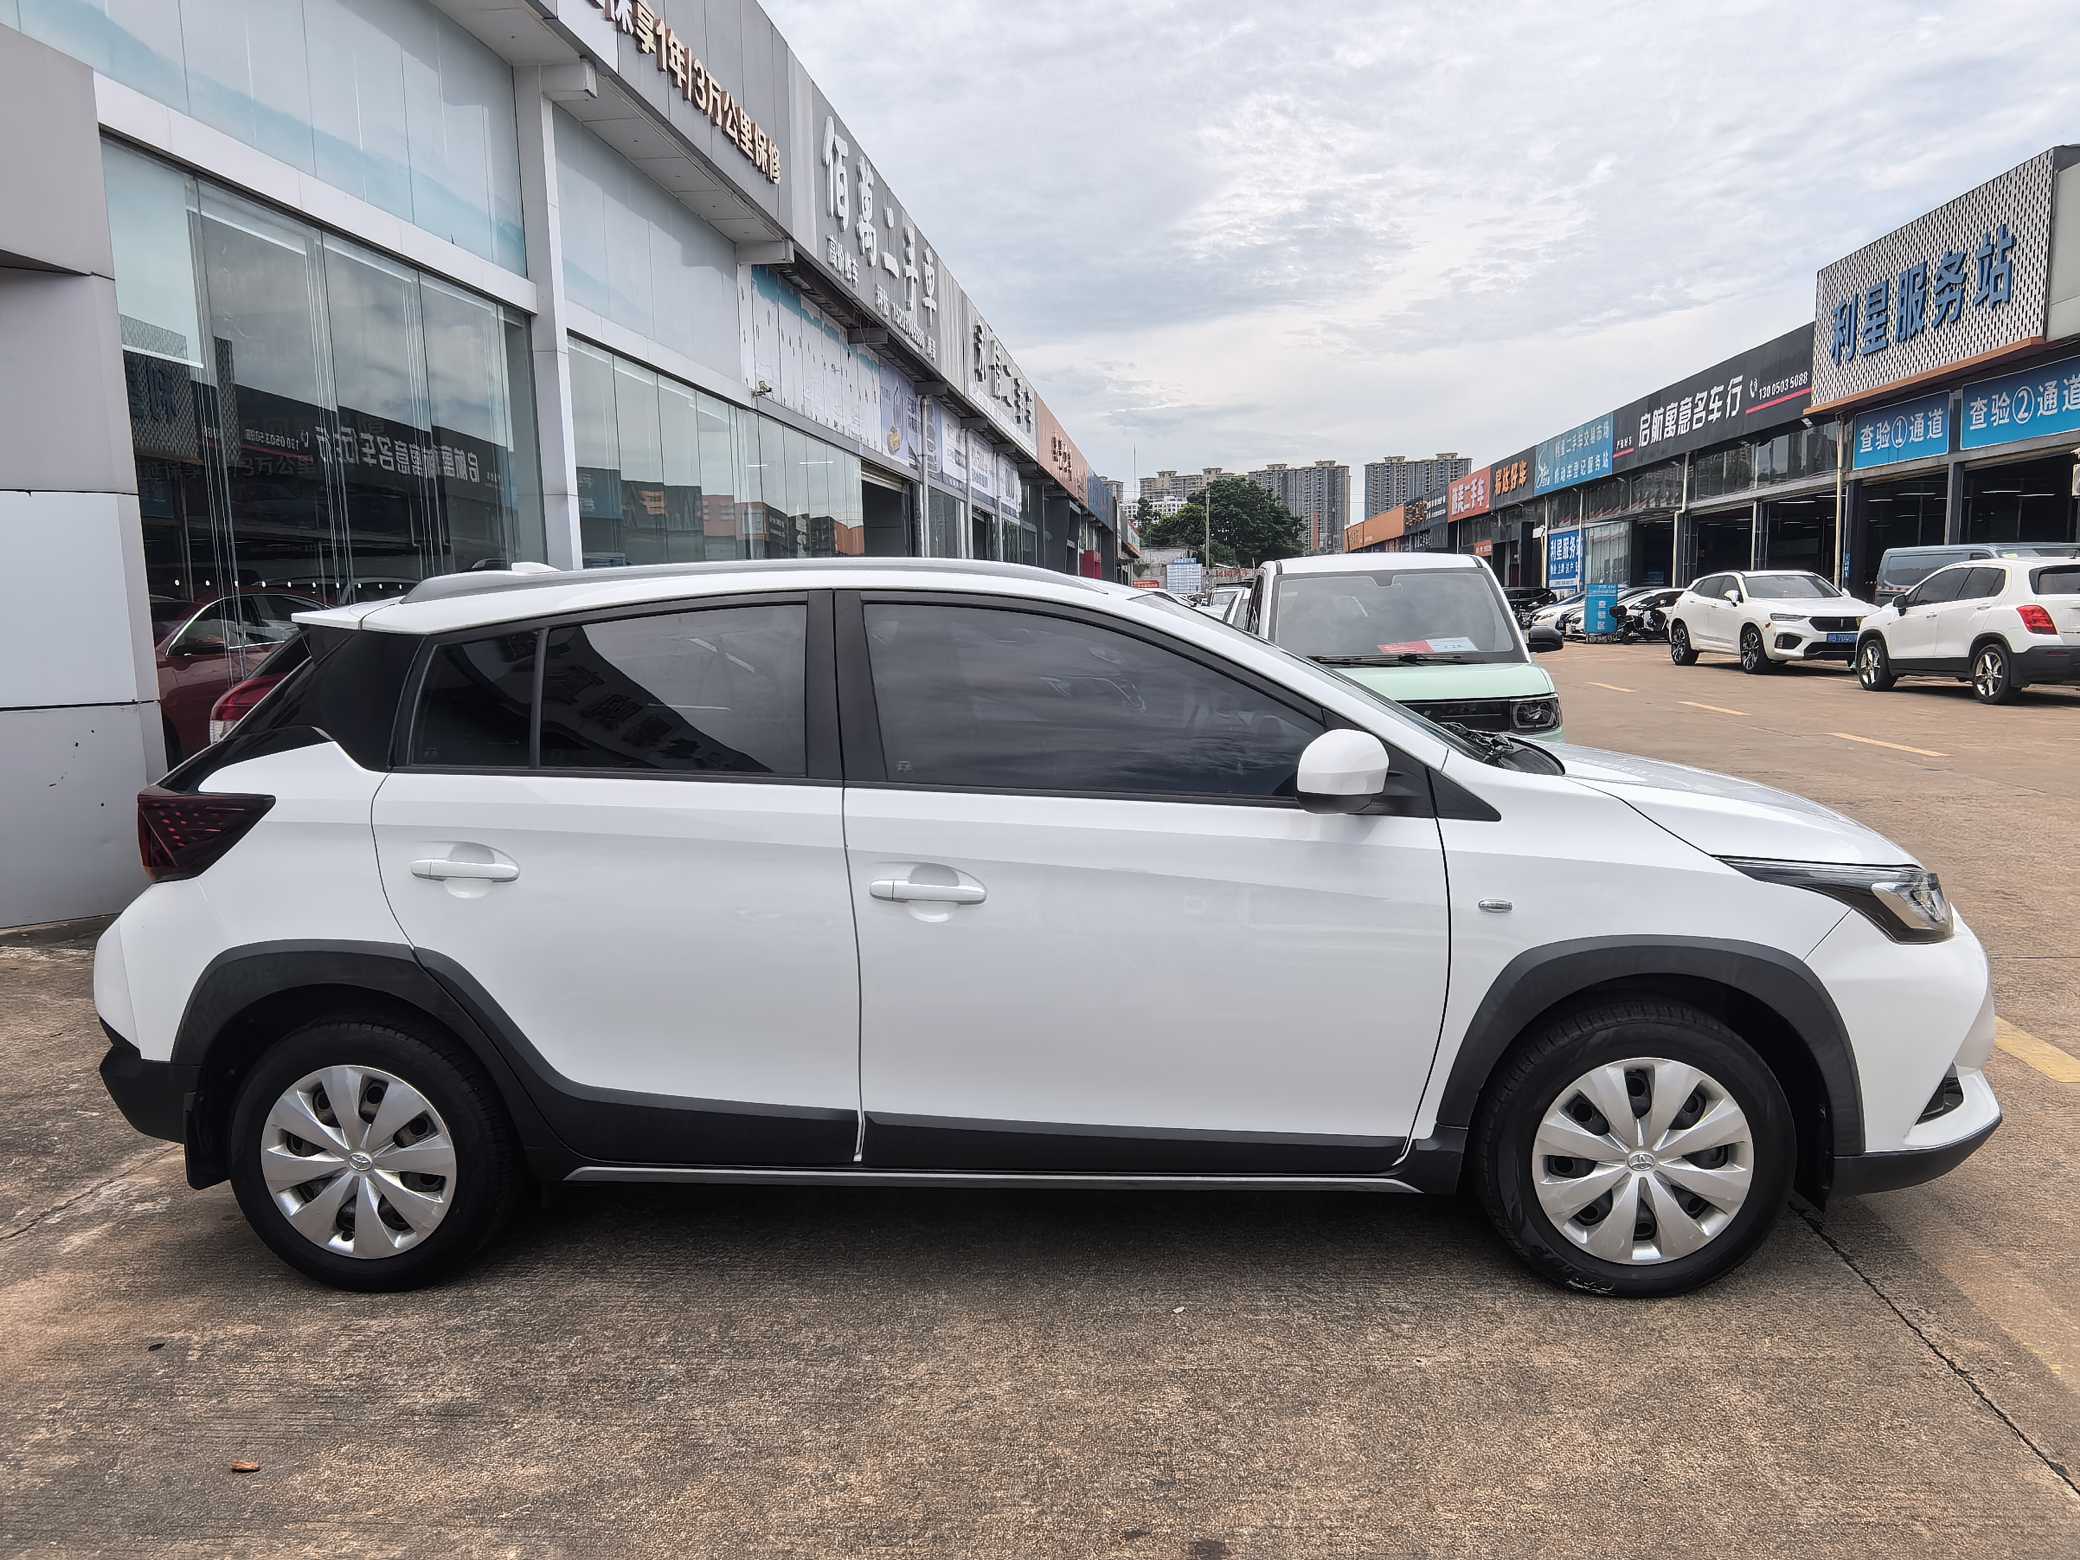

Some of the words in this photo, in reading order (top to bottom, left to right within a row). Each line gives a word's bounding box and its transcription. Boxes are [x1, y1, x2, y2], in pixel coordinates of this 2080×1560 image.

[1829, 223, 2016, 366] 利星服务站
[1638, 375, 1744, 448] 启航寓意名车行
